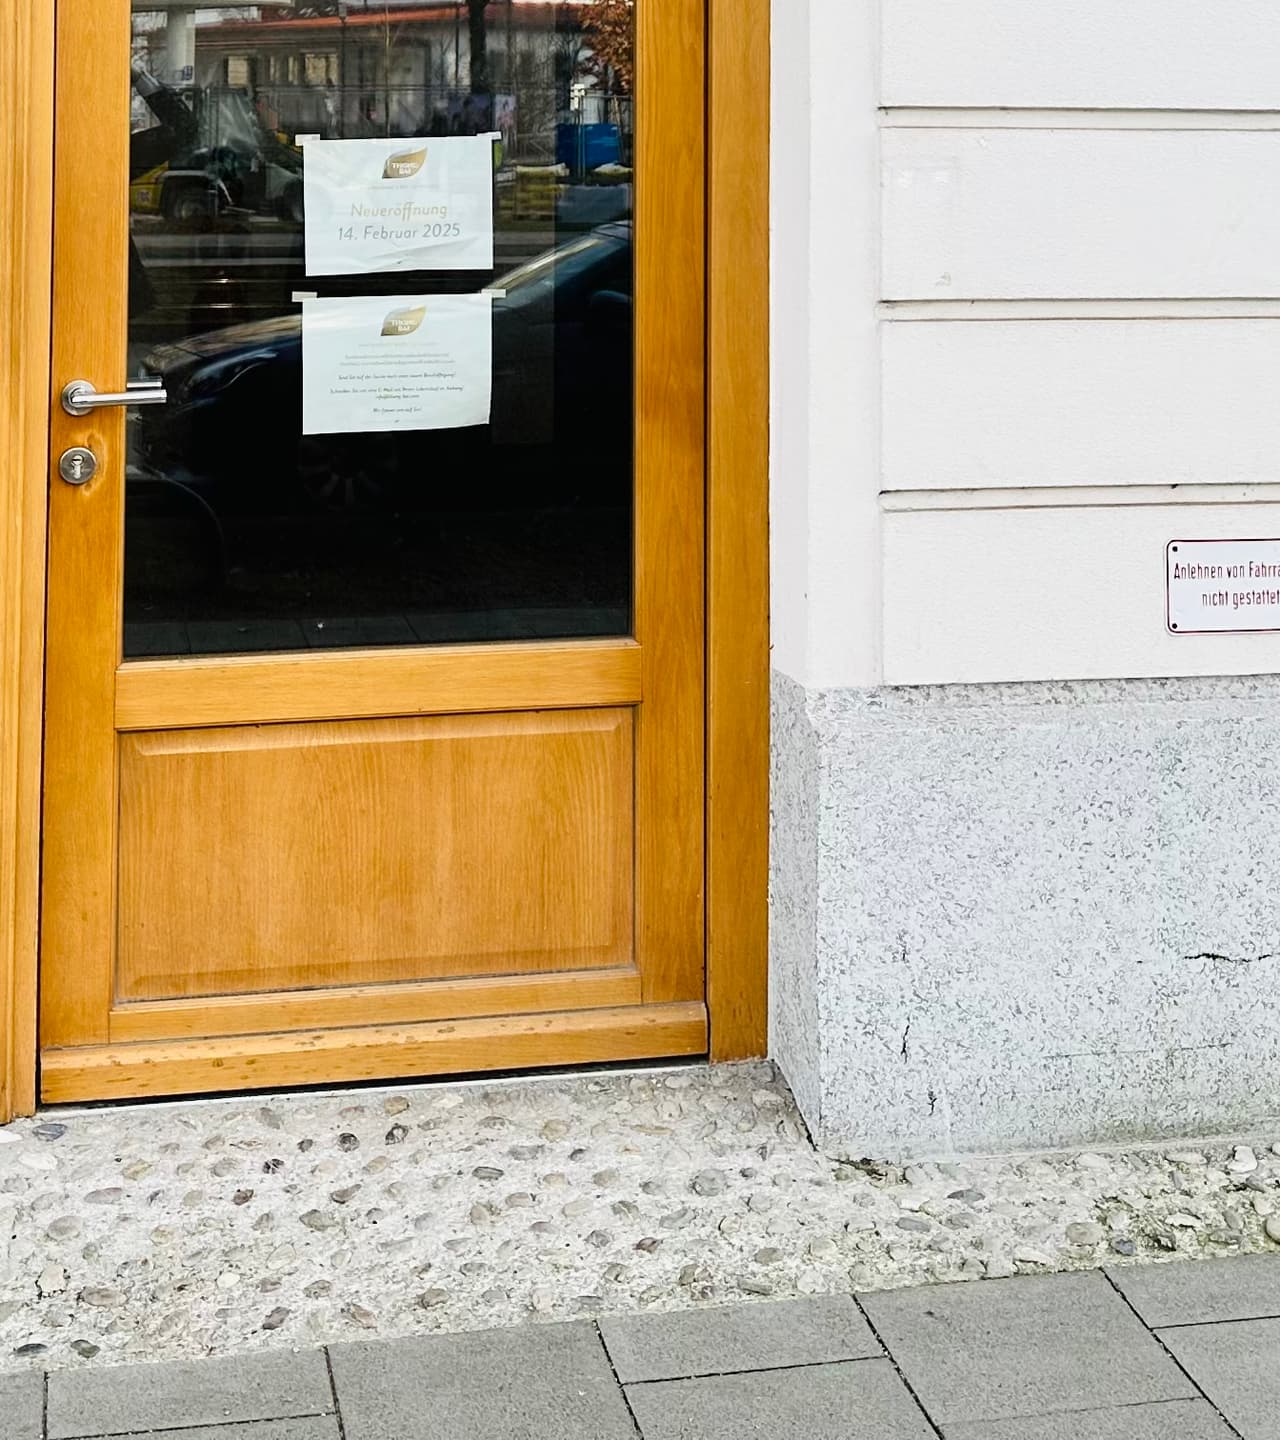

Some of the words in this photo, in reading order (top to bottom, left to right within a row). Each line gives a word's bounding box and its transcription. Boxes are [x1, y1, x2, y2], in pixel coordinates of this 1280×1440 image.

[338, 227, 358, 240] 14.
[364, 225, 417, 240] Februar
[422, 223, 461, 238] 2025
[1174, 563, 1223, 579] Anlehnen
[1227, 565, 1245, 578] von
[1202, 590, 1229, 606] nicht
[1232, 589, 1280, 610] gestattet
